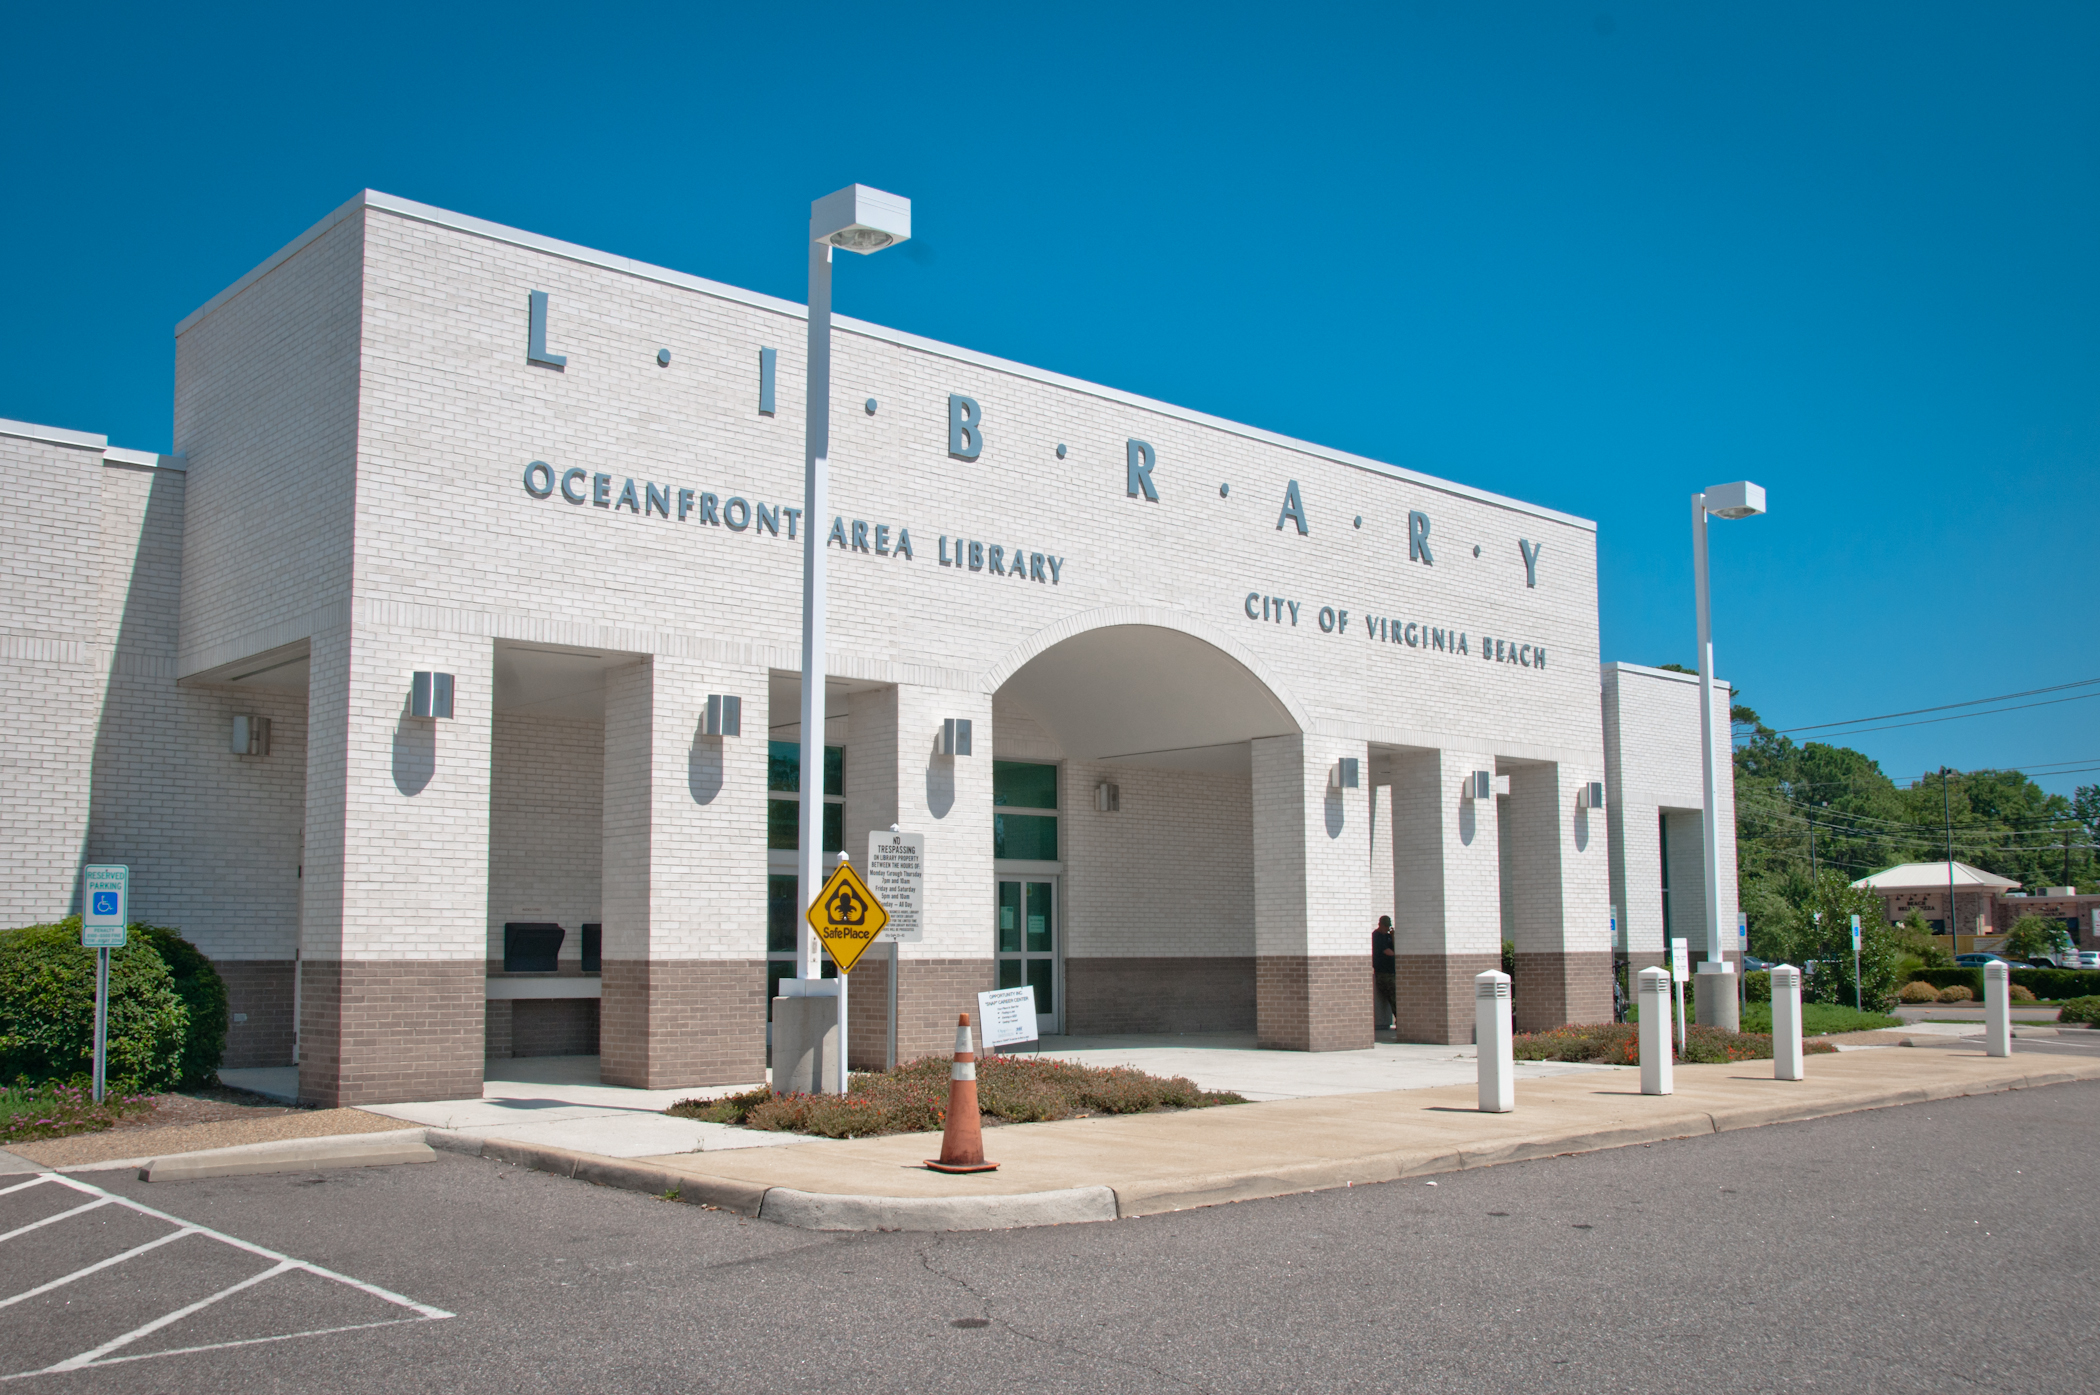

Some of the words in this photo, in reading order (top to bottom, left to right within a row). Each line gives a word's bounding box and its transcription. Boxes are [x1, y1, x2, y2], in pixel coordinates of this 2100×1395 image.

[523, 459, 803, 540] OCEANFRONT
[827, 515, 914, 561] AREA
[938, 534, 1065, 586] LIBRARY
[1244, 591, 1302, 627] CITY
[1318, 605, 1349, 635] OF
[1365, 613, 1469, 656] VIRGINIA
[1481, 636, 1547, 670] BEACH
[893, 836, 900, 845] NO
[877, 845, 916, 855] TRESPASSING
[87, 871, 125, 880] RESERVED
[869, 869, 886, 877] Monday
[903, 870, 922, 879] Thursday
[89, 881, 122, 890] PARKING
[875, 884, 888, 892] Friday
[897, 885, 916, 893] Saturday
[905, 901, 913, 909] Day
[823, 926, 843, 939] Safe
[843, 927, 870, 939] Place
